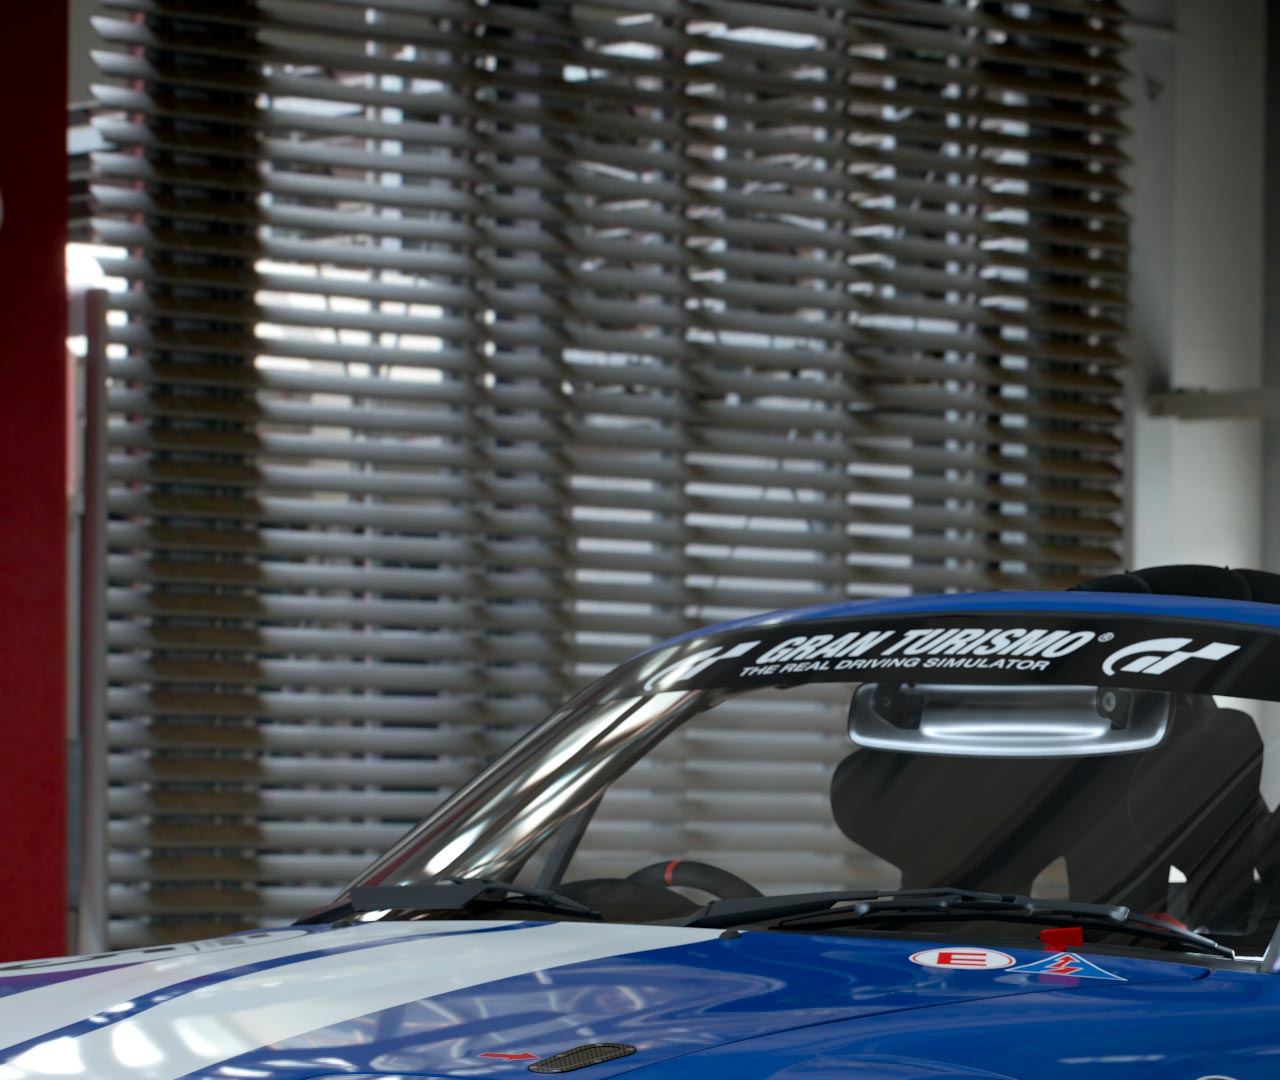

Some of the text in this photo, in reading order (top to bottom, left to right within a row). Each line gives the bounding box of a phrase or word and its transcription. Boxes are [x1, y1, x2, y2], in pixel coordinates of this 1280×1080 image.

[756, 630, 896, 664] GRAN
[739, 657, 1051, 677] THE REAL DRIVING SIMULATOR
